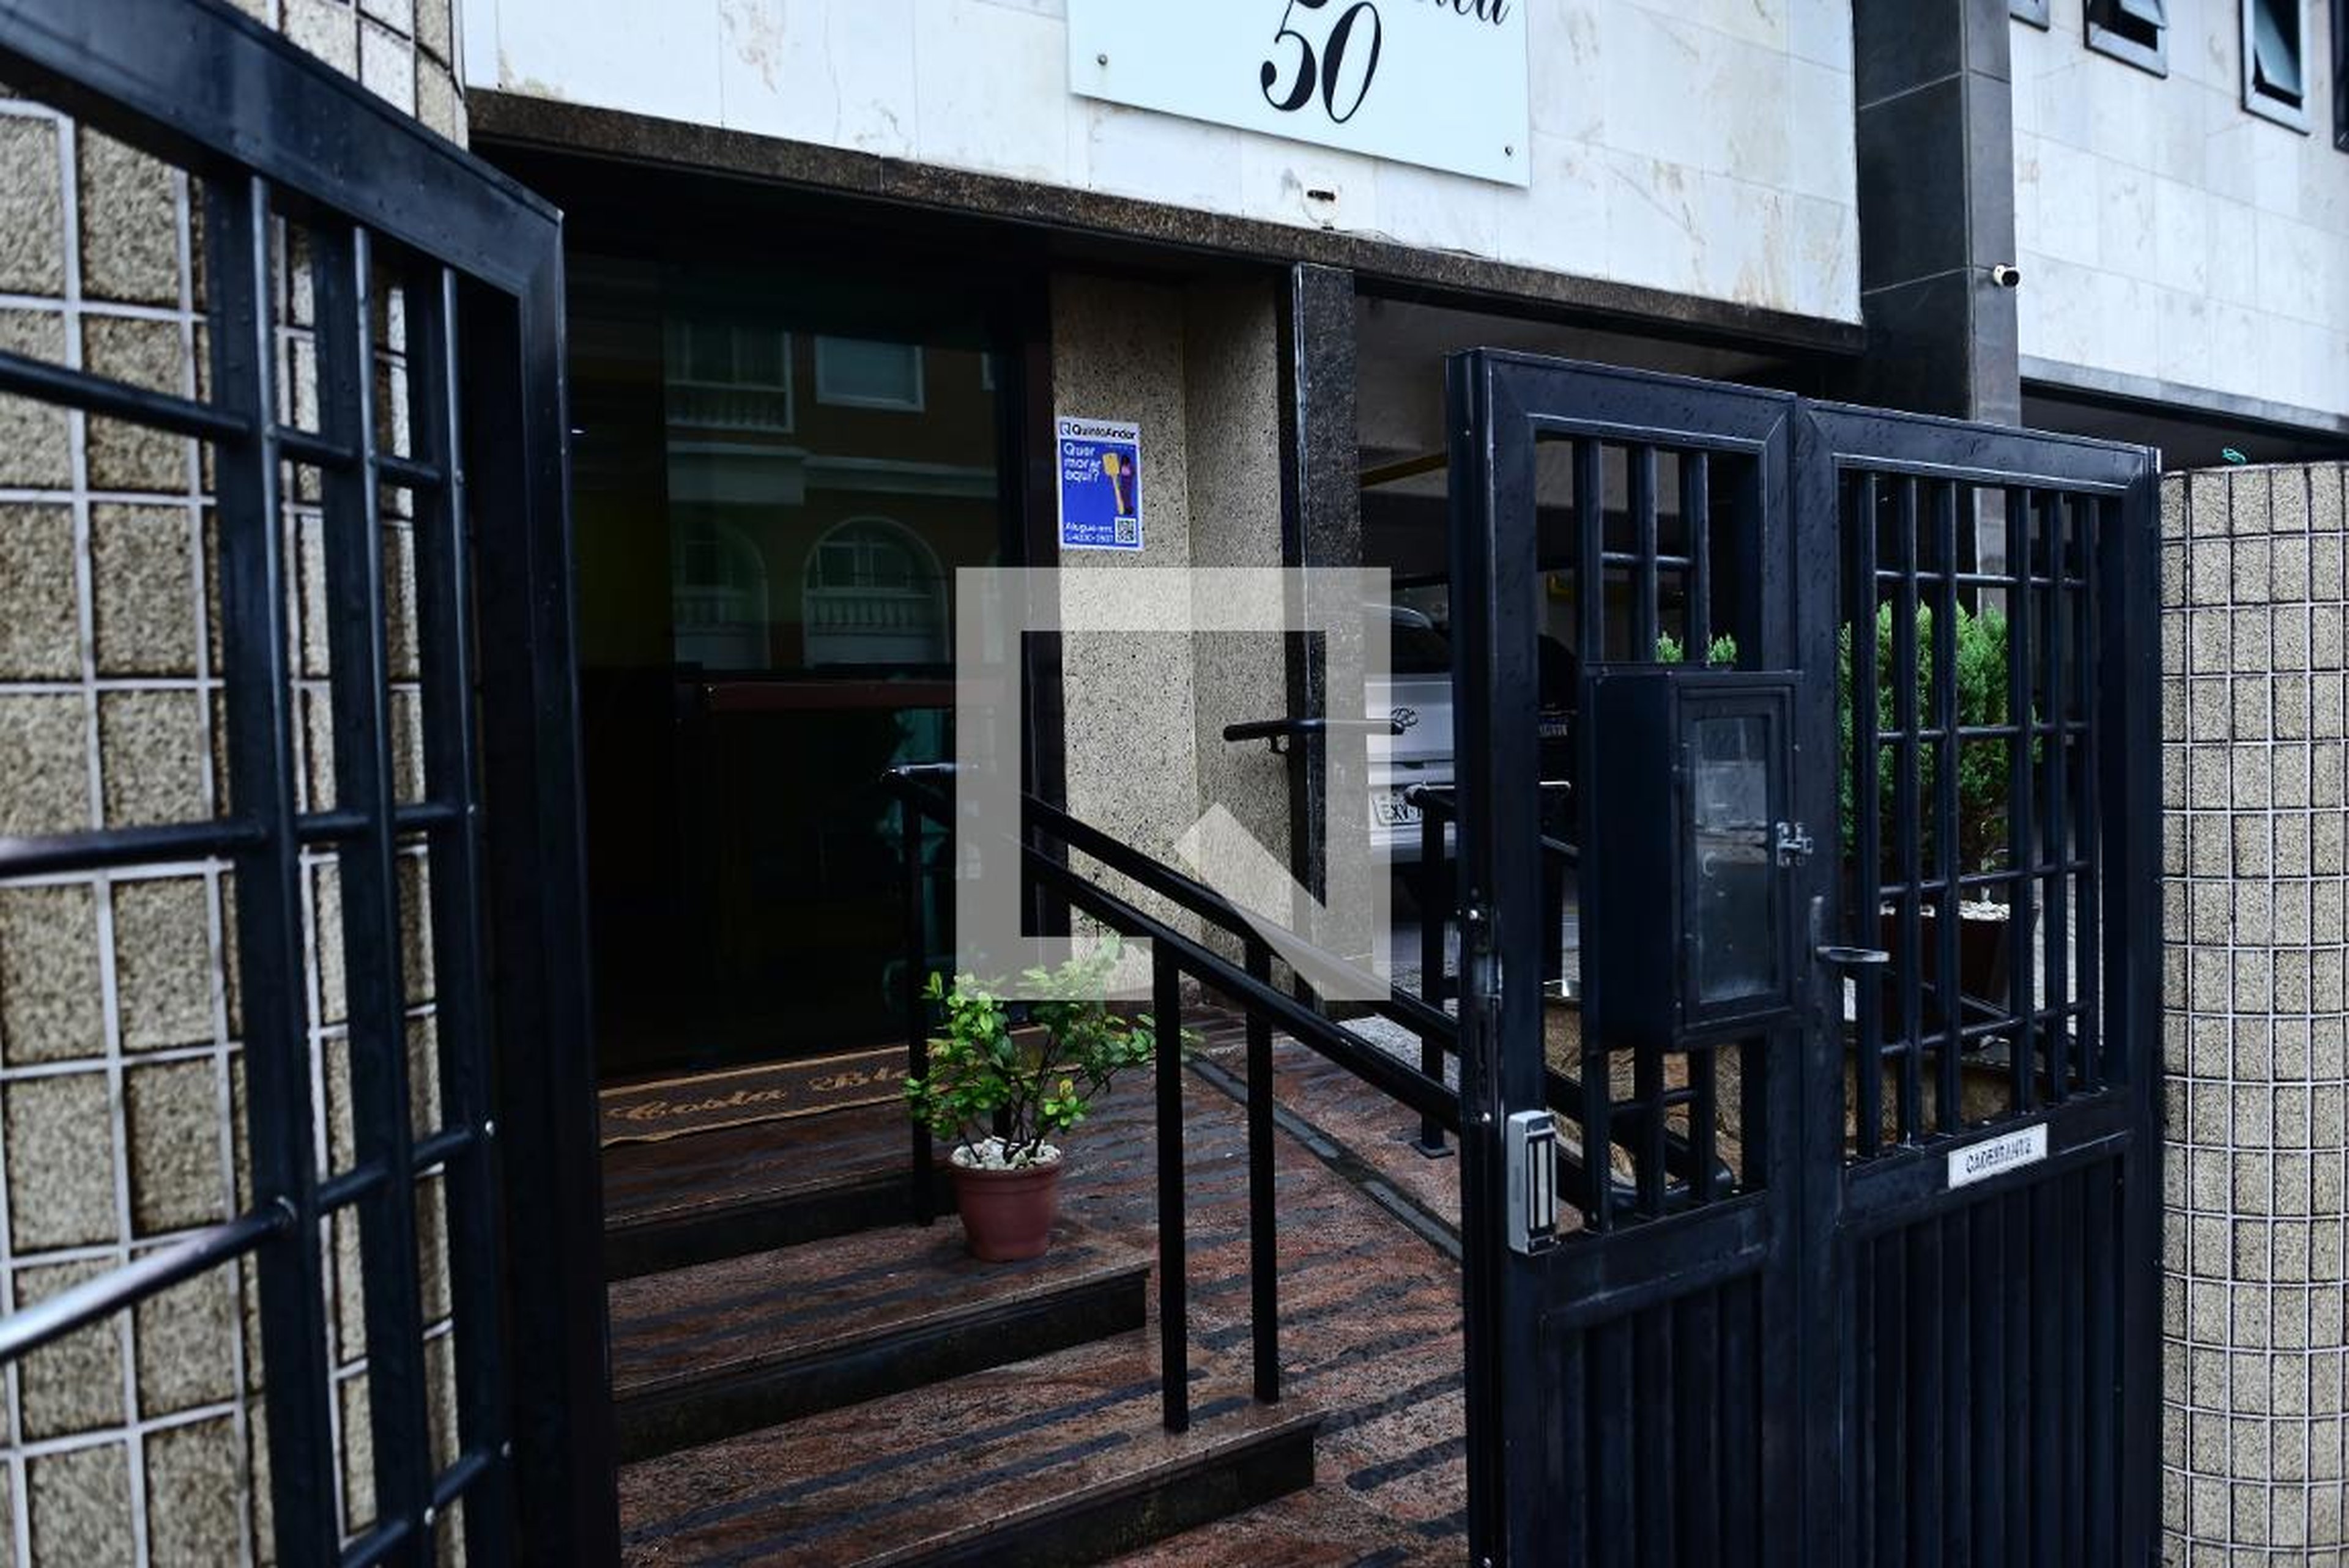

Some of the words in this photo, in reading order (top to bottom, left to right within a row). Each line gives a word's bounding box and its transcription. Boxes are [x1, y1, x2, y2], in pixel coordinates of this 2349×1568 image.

[1261, 0, 1381, 124] 50
[1072, 424, 1136, 439] QuintoAndar
[1064, 442, 1095, 456] Quer
[1064, 459, 1101, 469] morar
[1064, 469, 1100, 483] aqui?
